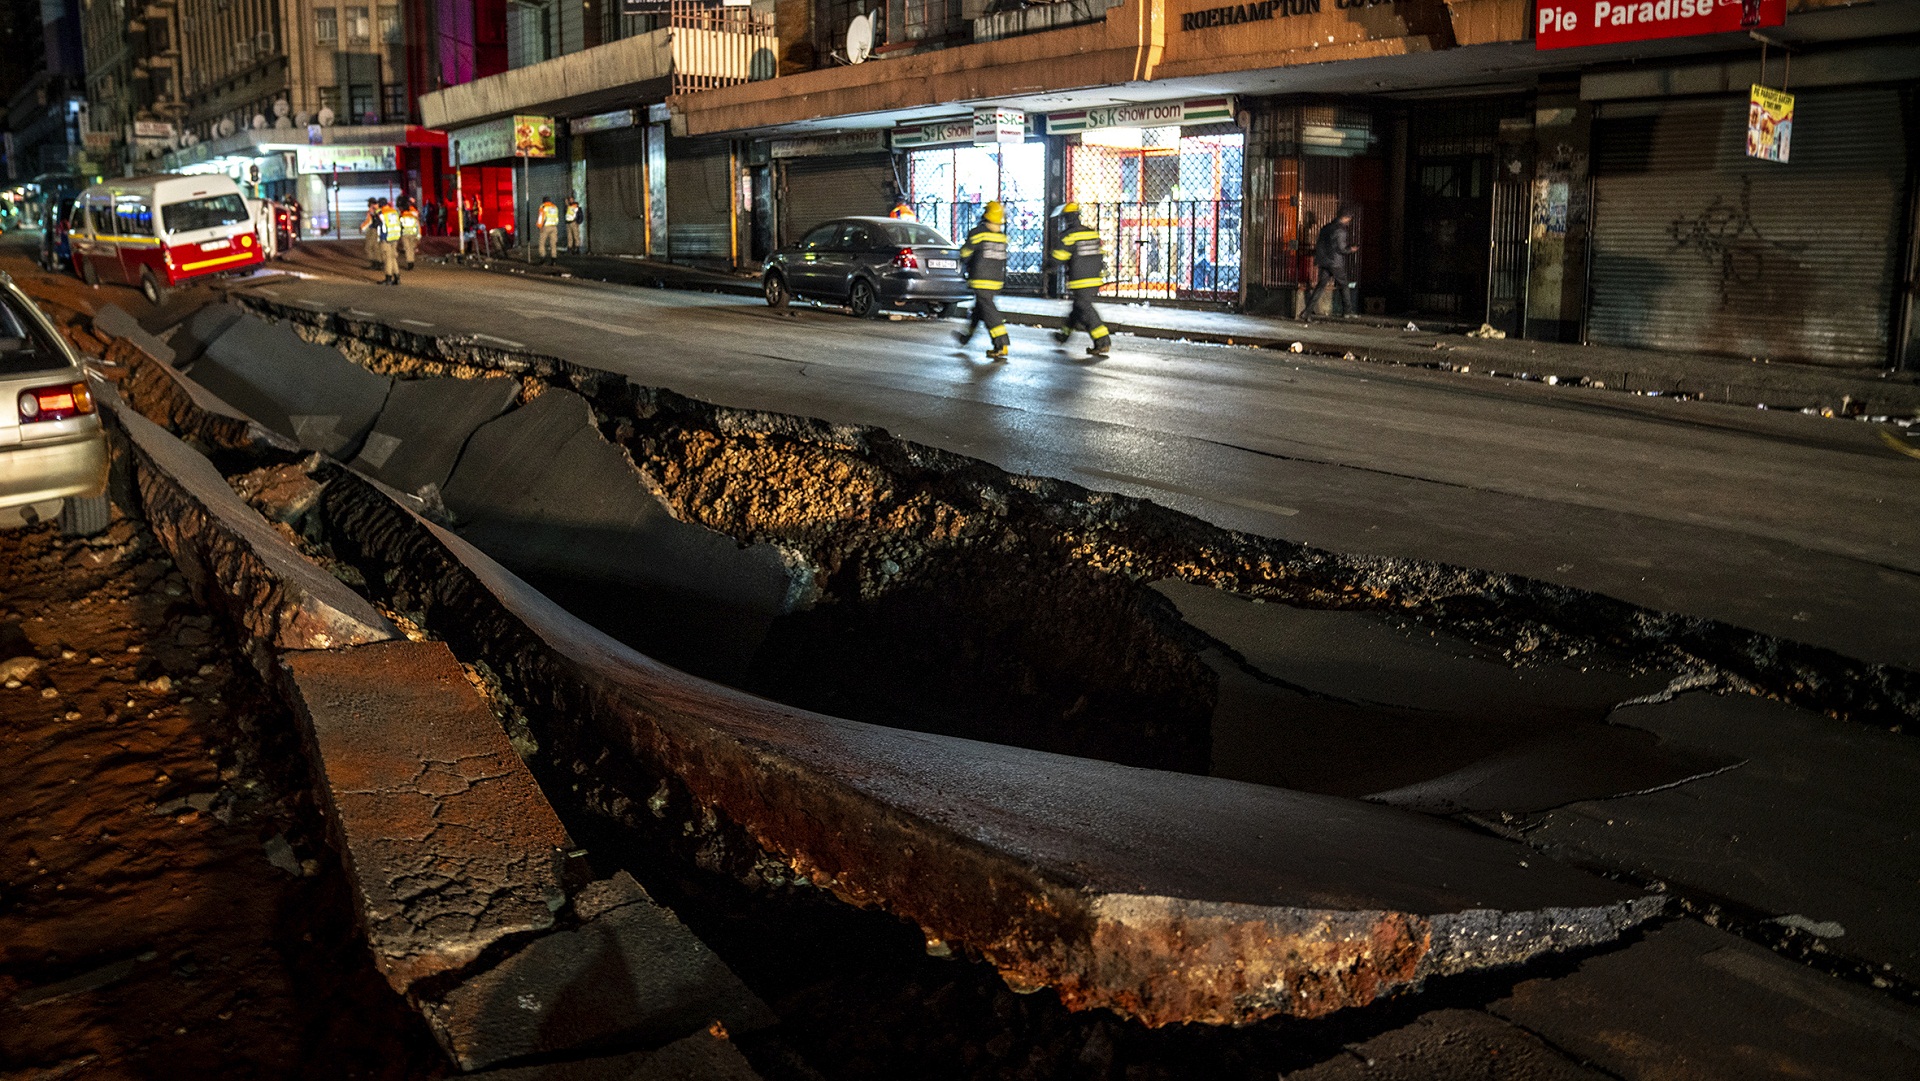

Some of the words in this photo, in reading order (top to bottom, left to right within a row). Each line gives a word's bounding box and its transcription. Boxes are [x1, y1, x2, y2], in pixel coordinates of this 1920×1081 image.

[1182, 0, 1320, 31] ROEHAMPTON
[1539, 7, 1578, 34] Pie
[1594, 0, 1713, 28] Paradise
[1088, 108, 1116, 128] S&K
[1117, 104, 1181, 122] showroom
[946, 125, 973, 138] showr
